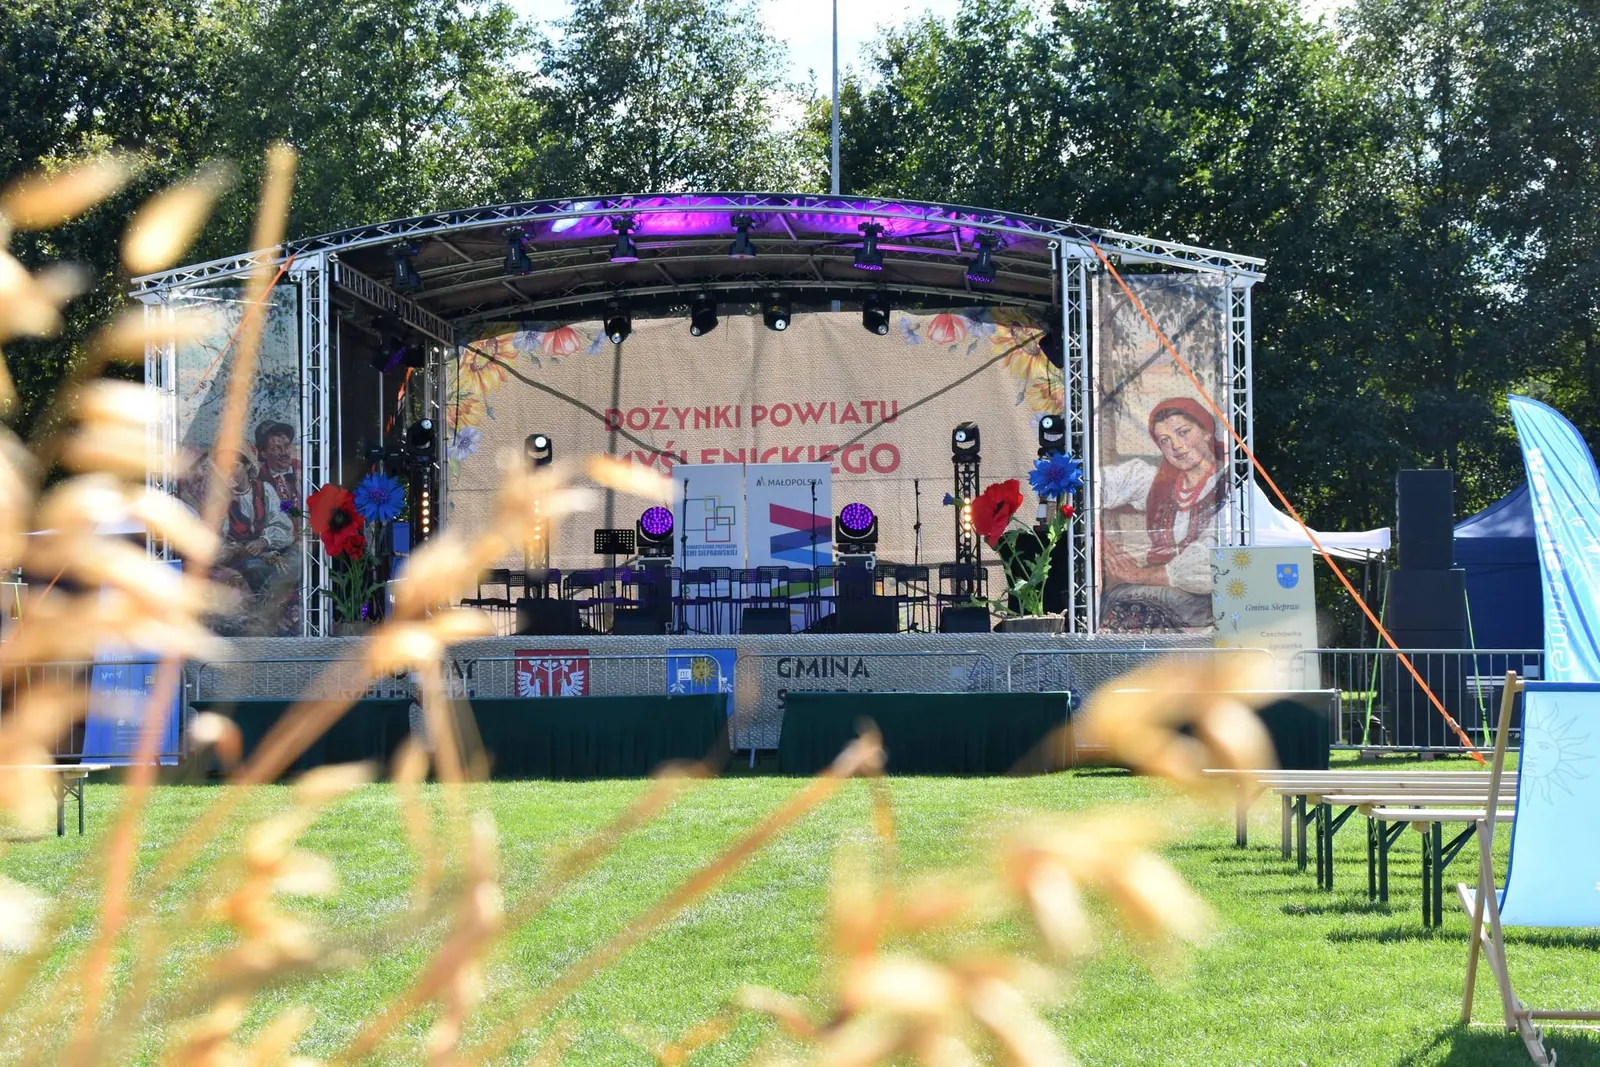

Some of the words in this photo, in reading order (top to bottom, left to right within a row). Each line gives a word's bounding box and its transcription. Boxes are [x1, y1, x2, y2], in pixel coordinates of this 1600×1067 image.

[605, 400, 741, 431] DOŻYNKI
[751, 400, 898, 428] POWIATU
[1244, 604, 1270, 612] Gmina
[777, 657, 870, 678] GMINA
